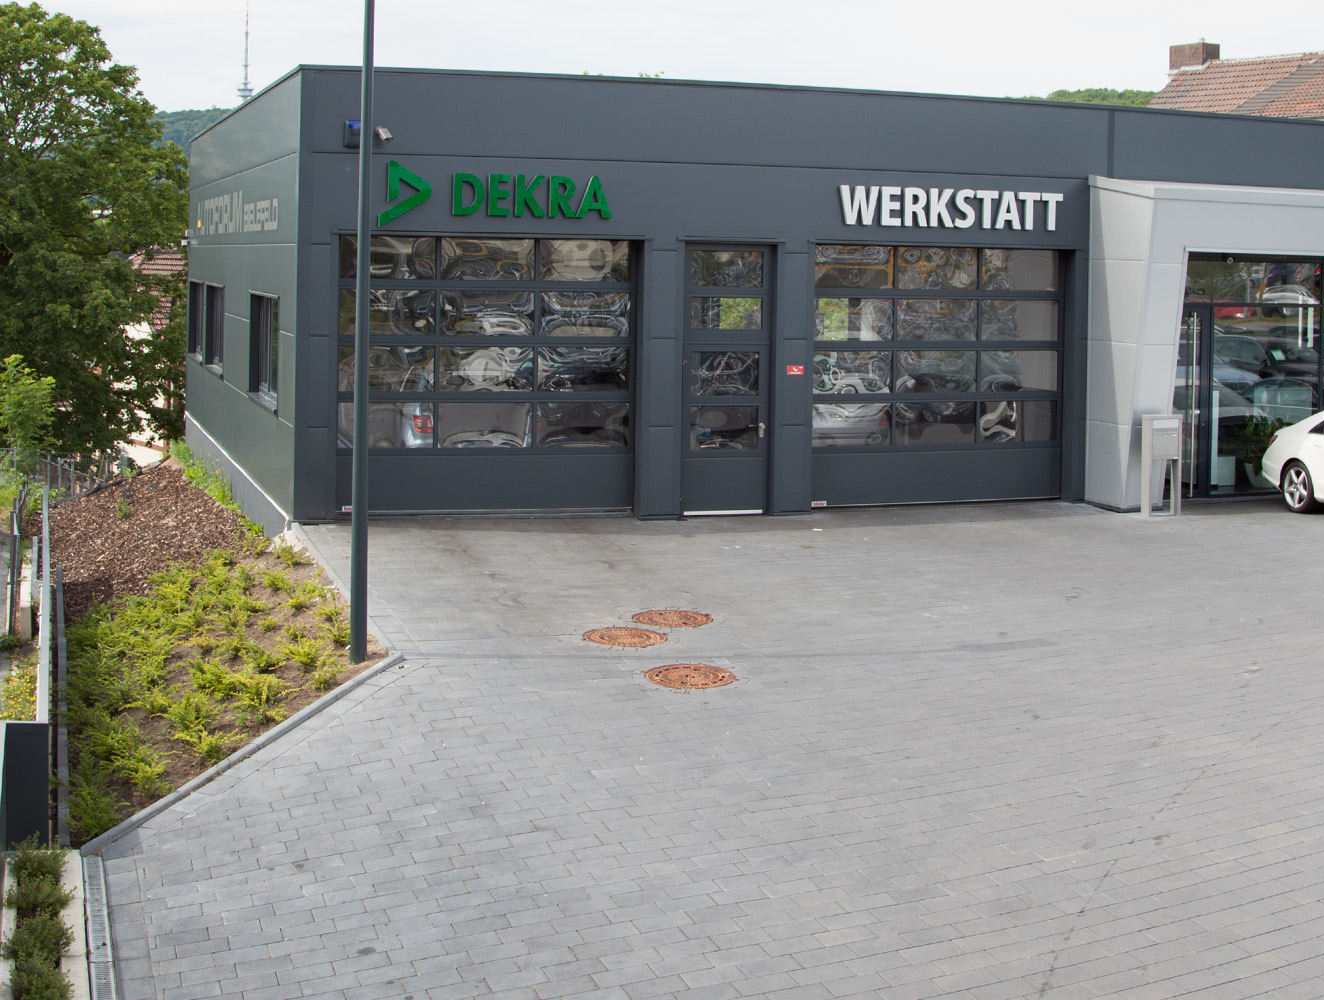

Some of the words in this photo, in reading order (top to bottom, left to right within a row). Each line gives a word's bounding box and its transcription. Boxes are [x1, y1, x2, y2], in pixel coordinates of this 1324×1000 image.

[196, 189, 243, 236] AUTOFORUM
[243, 198, 279, 232] BIELEFELD
[452, 172, 612, 219] DEKRA
[838, 184, 1064, 231] WERKSTATT
